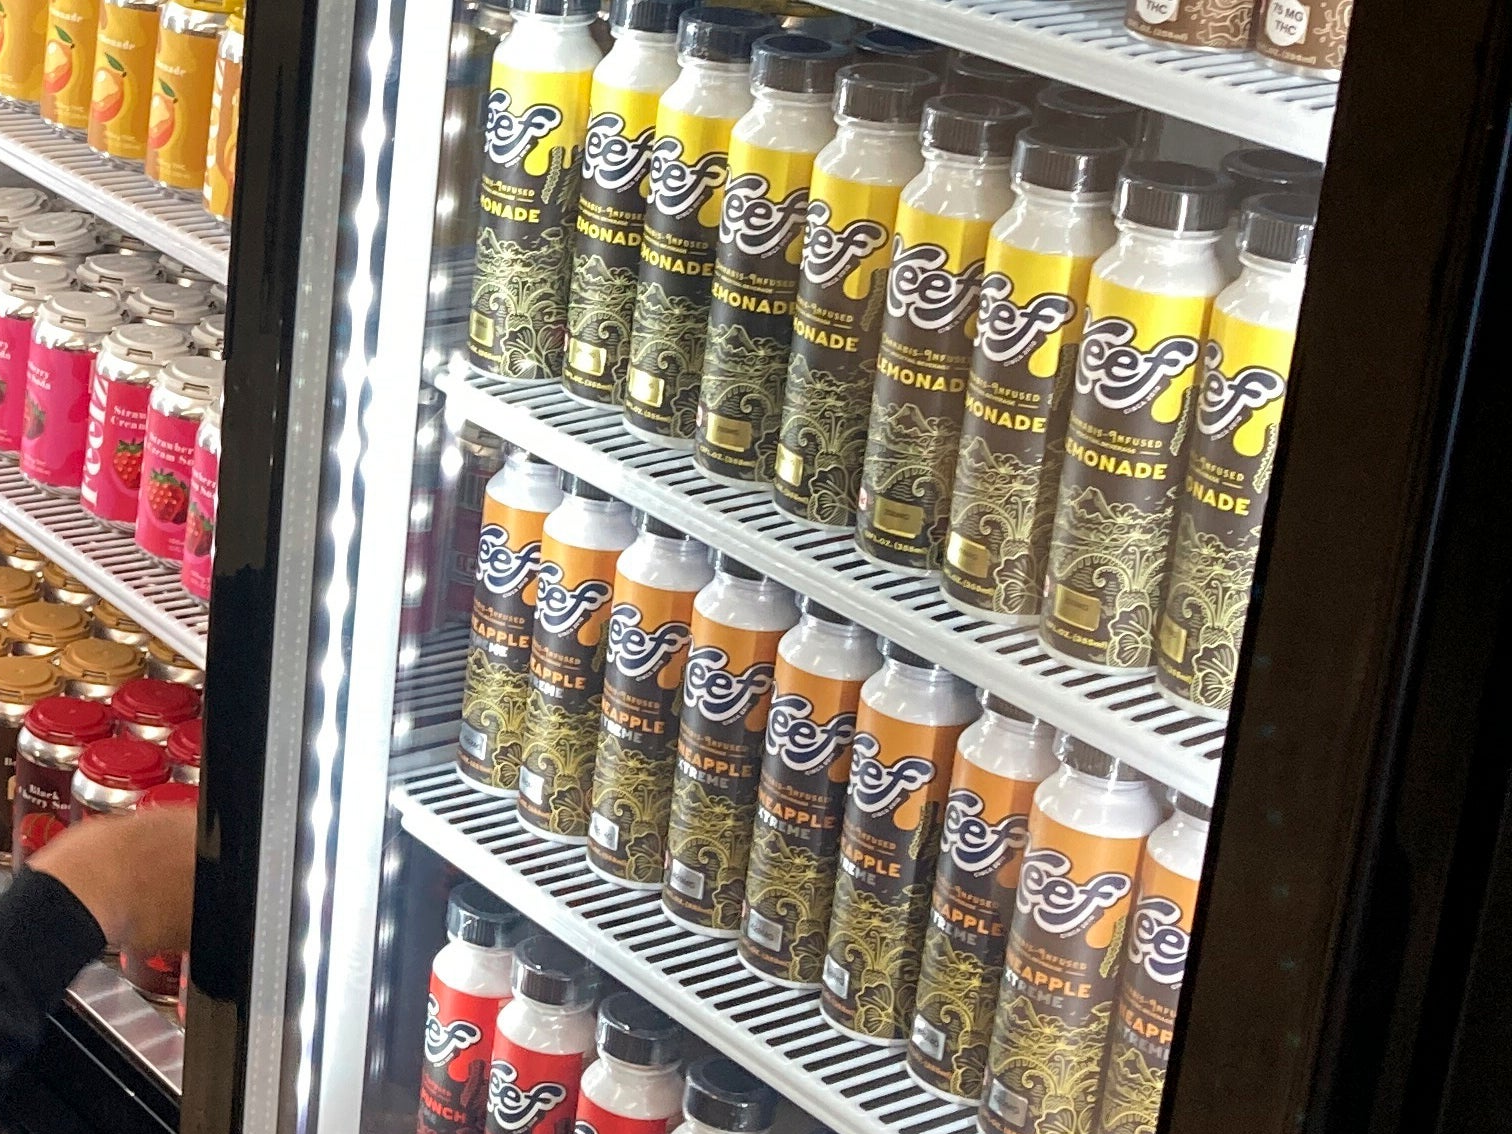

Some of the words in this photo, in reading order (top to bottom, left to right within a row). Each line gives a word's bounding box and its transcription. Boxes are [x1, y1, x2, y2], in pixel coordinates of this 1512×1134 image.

[1274, 20, 1297, 36] THC
[1284, 8, 1304, 22] MG
[877, 355, 965, 392] LEMONAD
[965, 393, 1047, 434] MONADE
[29, 784, 59, 801] Black
[1129, 889, 1187, 984] Kee
